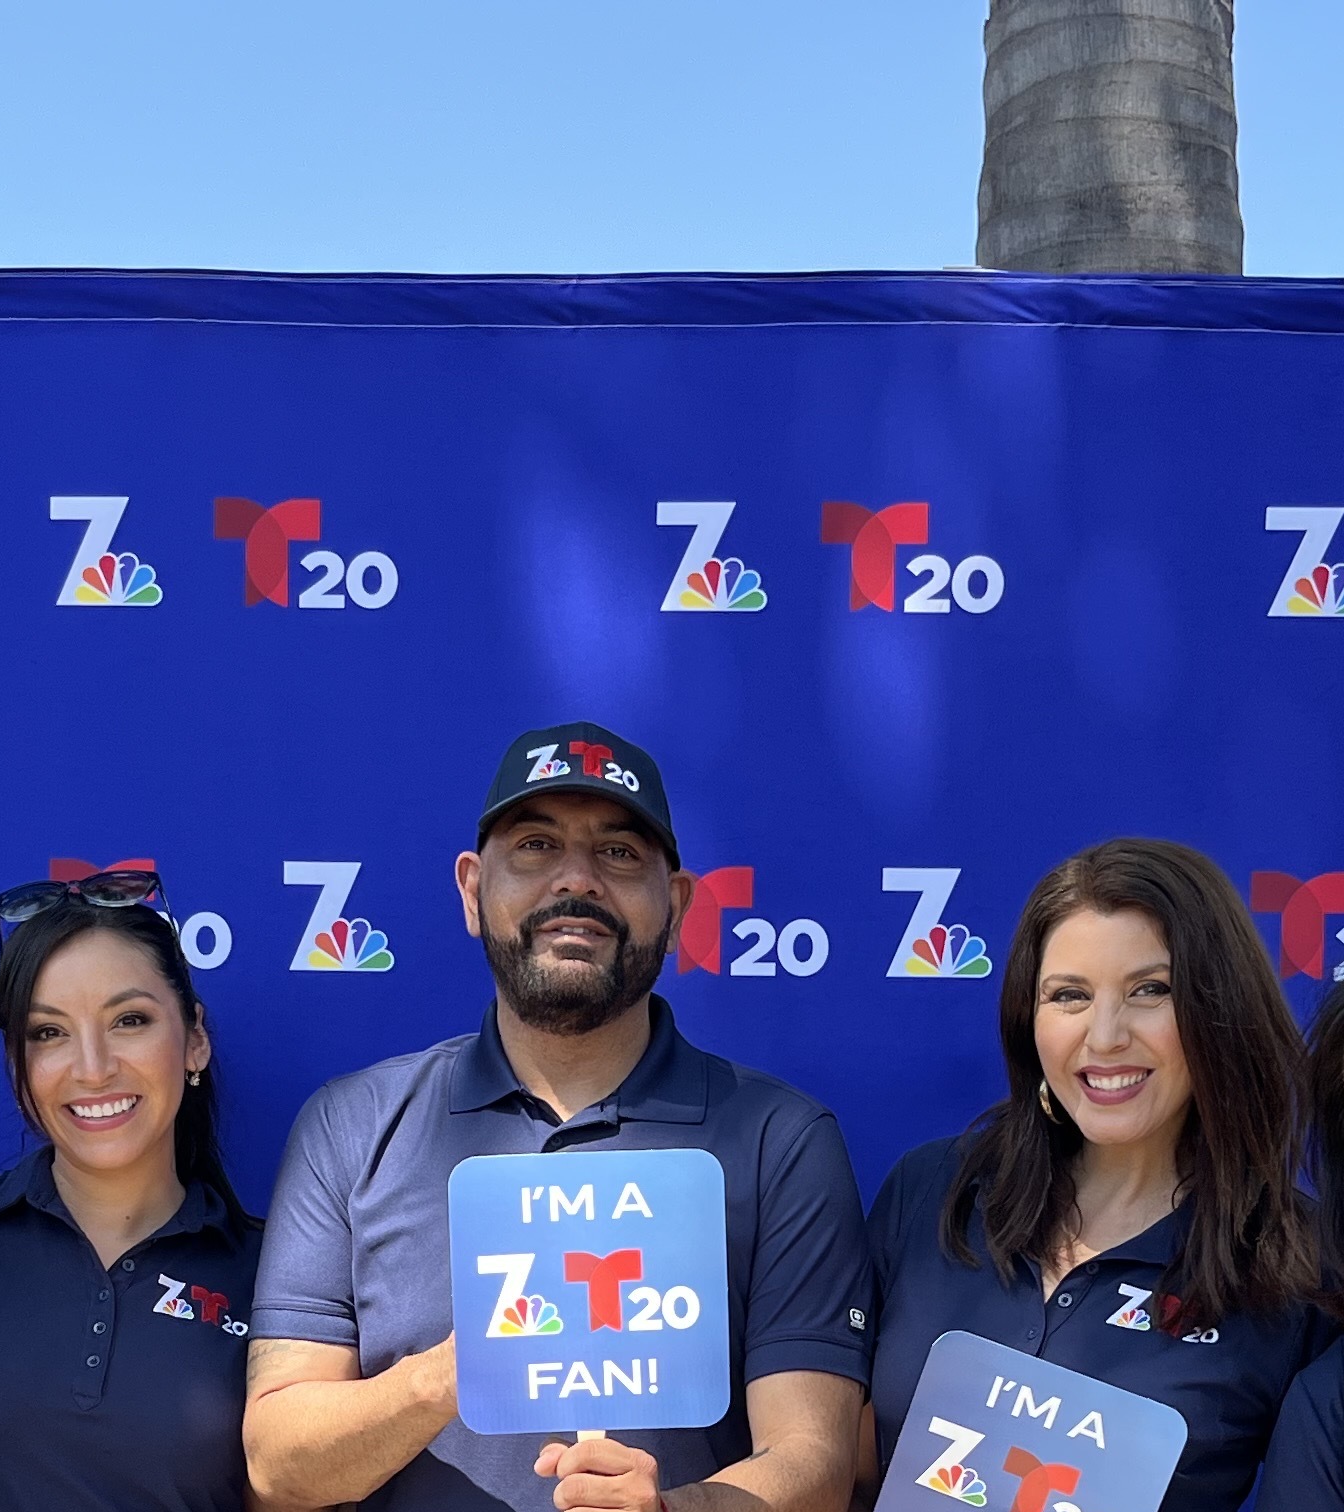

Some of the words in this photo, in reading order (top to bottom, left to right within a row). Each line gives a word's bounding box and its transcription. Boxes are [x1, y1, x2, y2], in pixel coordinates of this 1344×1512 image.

[49, 496, 130, 607] 7
[656, 501, 737, 612] 7
[525, 743, 560, 783] 7
[283, 861, 362, 972] 7
[882, 868, 962, 979] 7
[520, 1183, 596, 1224] I'M
[611, 1182, 654, 1220] A
[477, 1253, 536, 1338] 7
[1105, 1282, 1153, 1327] 7
[527, 1357, 659, 1400] FAN!
[985, 1375, 1062, 1430] I'M
[1066, 1410, 1106, 1450] A
[914, 1416, 986, 1495] 7
